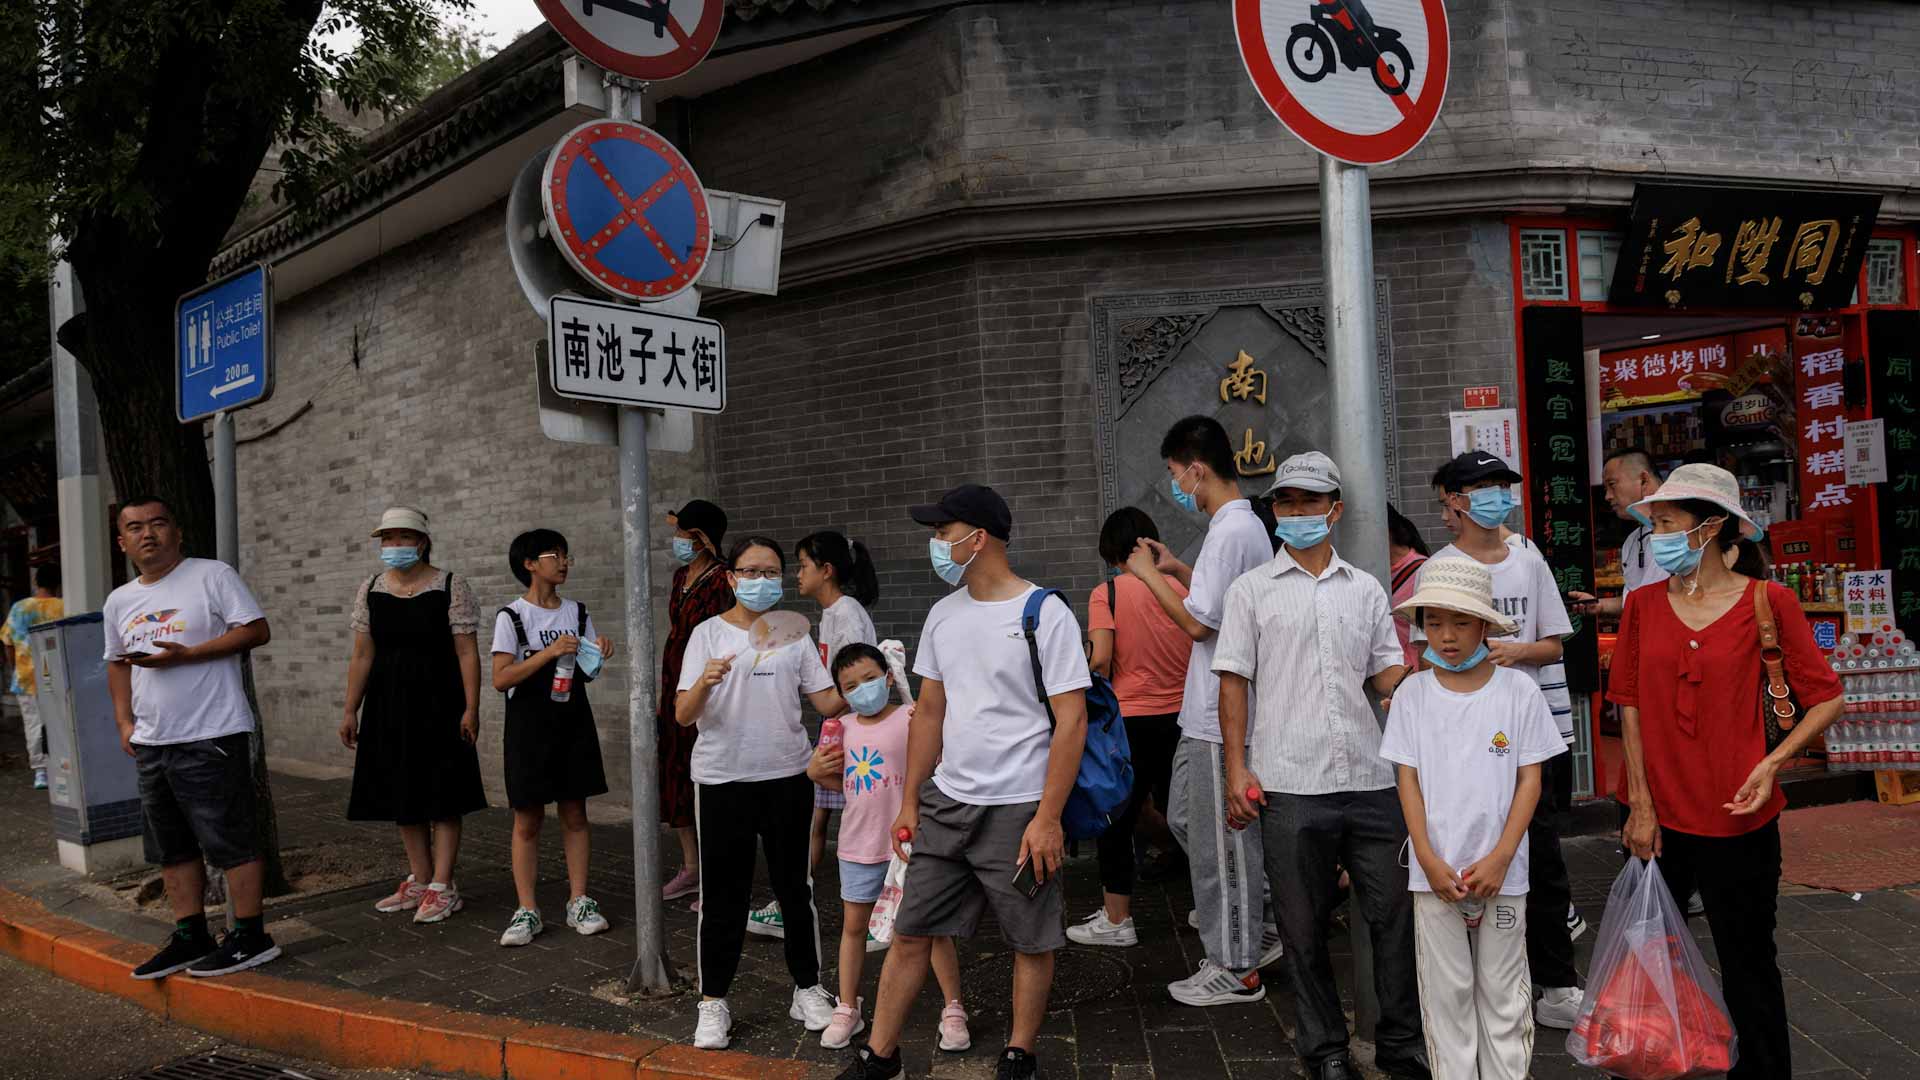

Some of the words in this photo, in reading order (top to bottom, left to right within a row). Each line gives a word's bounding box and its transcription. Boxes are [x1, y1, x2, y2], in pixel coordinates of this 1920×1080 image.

[216, 293, 262, 330] 公共卫生间
[216, 330, 240, 350] Public
[241, 320, 261, 341] Toilet
[561, 316, 717, 393] 南池子大街
[225, 363, 240, 382] 200
[241, 363, 249, 377] m
[1479, 395, 1485, 406] 1
[1801, 348, 1853, 509] 稻香村糕点
[1848, 587, 1887, 601] 饮料
[1848, 602, 1888, 616] 雪糕
[1813, 620, 1838, 650] 德
